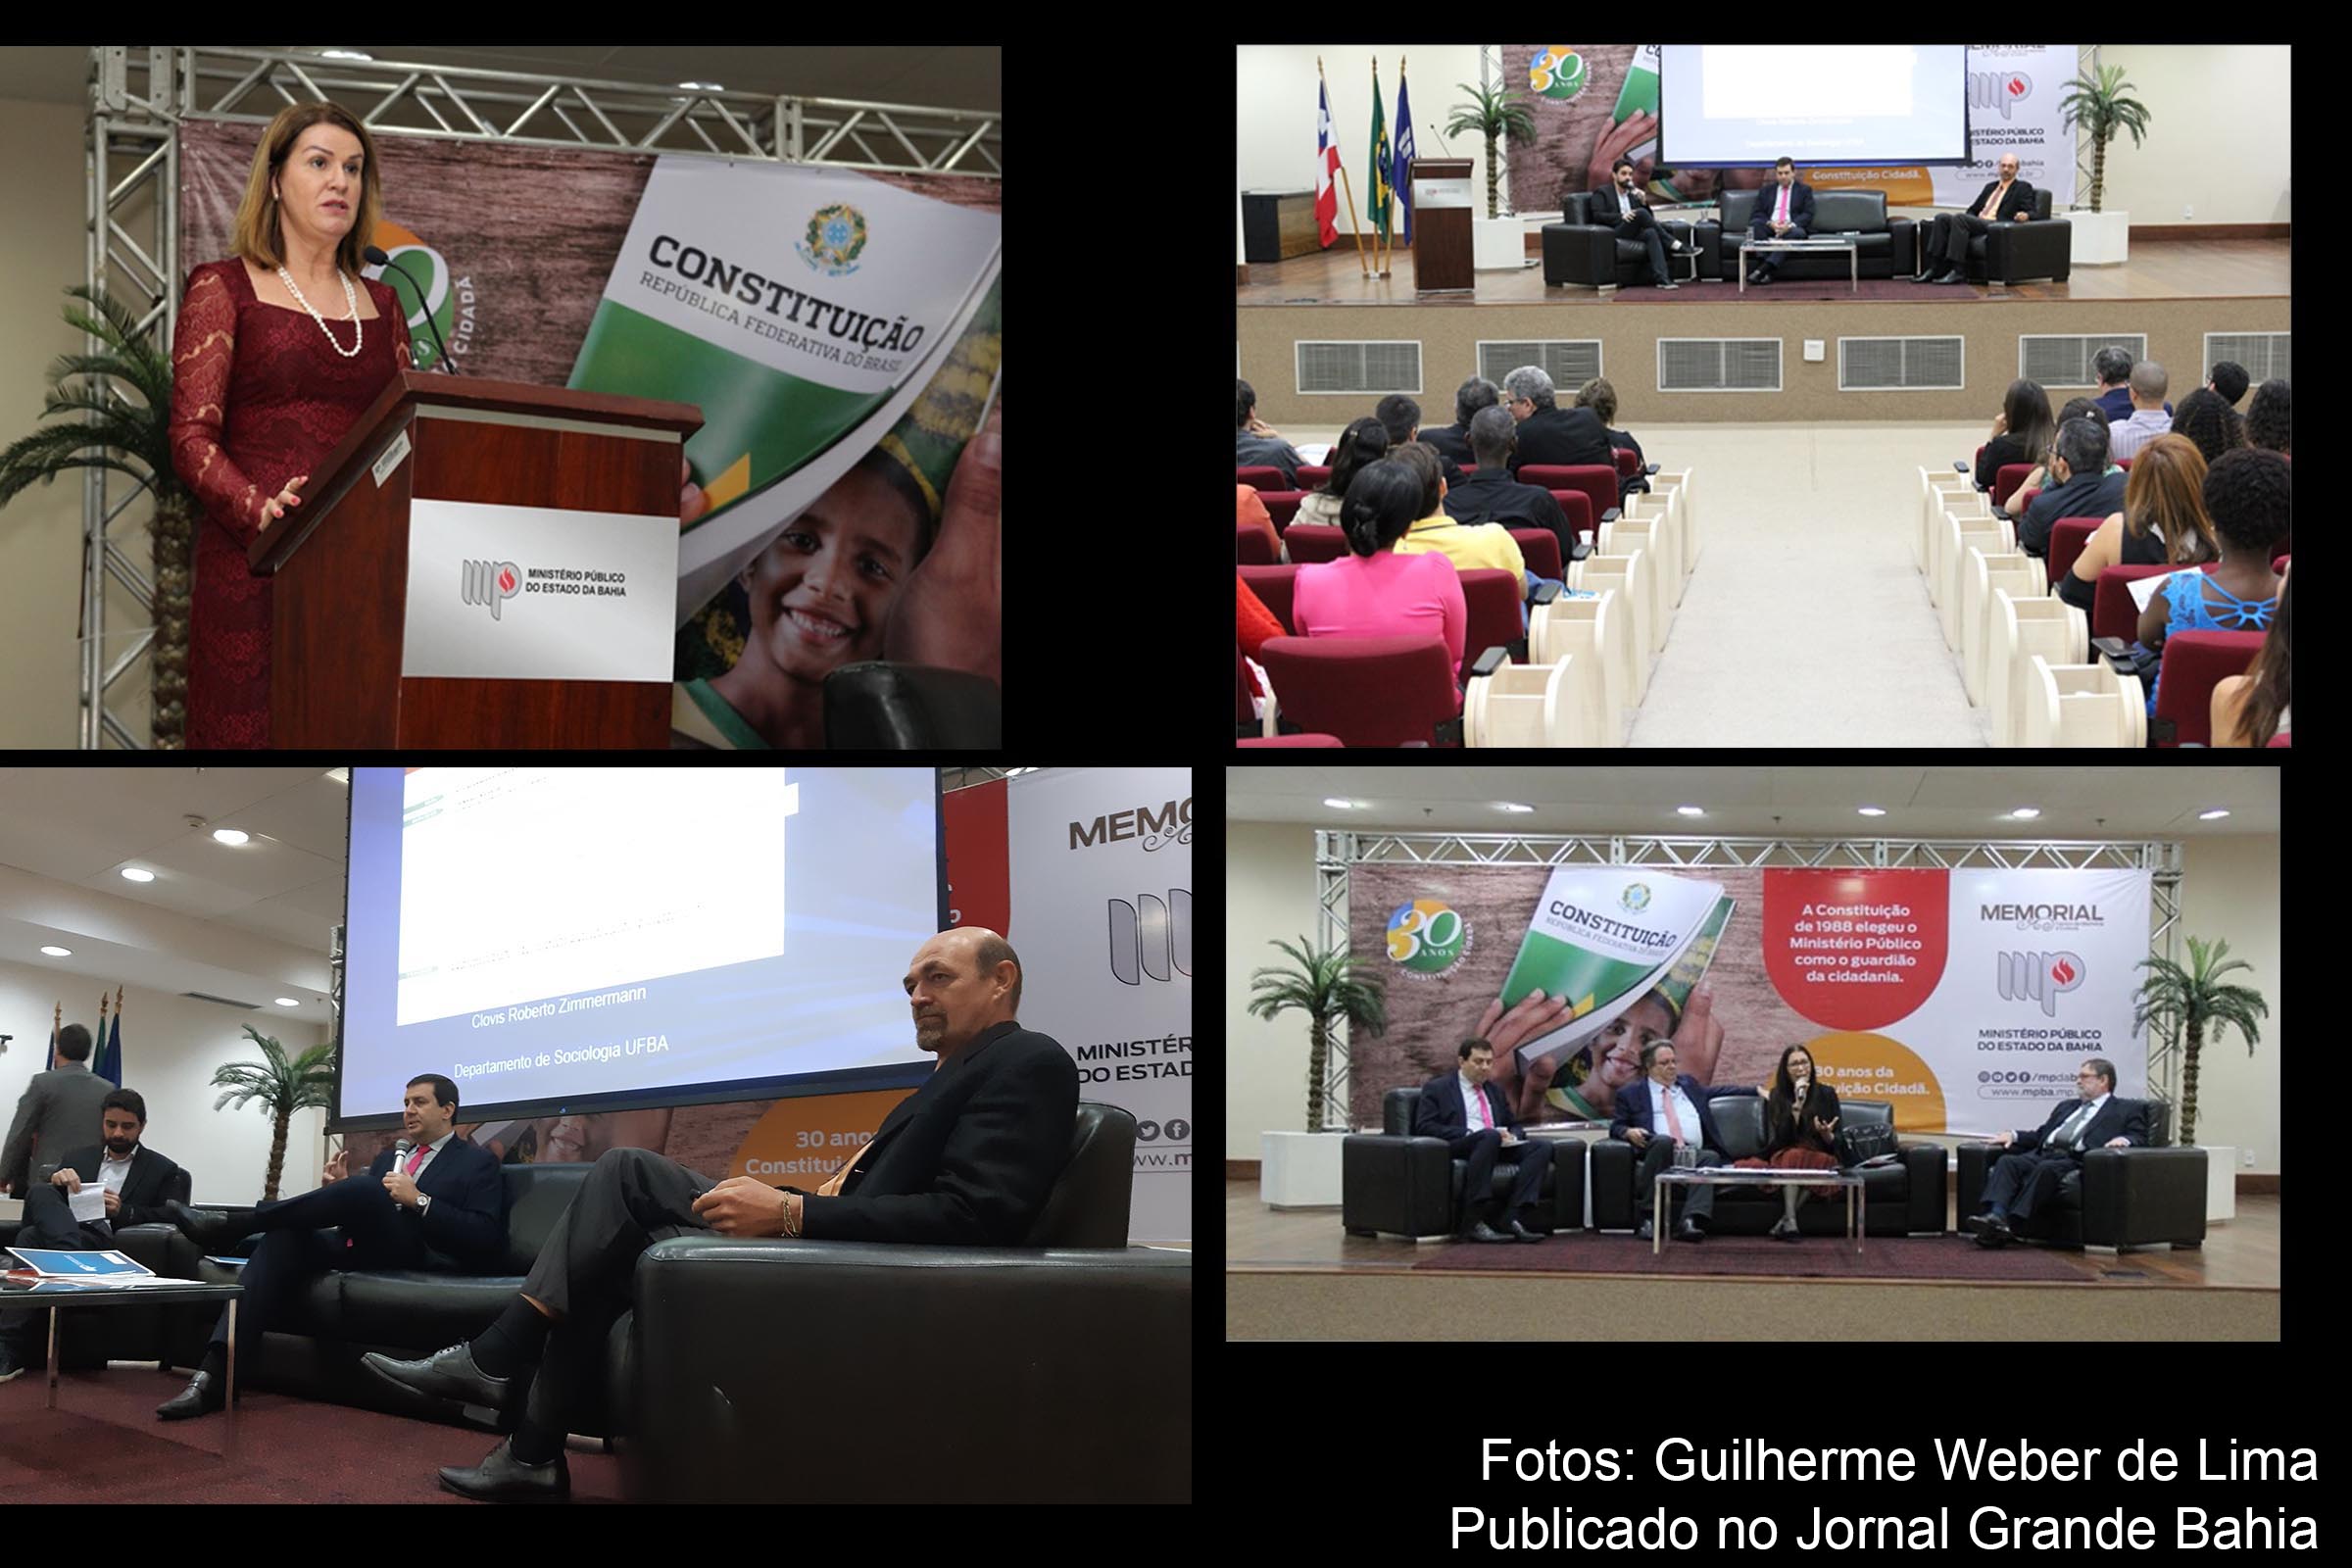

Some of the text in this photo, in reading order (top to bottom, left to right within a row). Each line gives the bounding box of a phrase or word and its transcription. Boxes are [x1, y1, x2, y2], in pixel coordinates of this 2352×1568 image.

[1530, 51, 1584, 92] 30
[648, 234, 925, 353] CONSTITUIÇÃO
[640, 270, 740, 325] REPÚBLICA
[744, 315, 841, 364] FEDERATIVA
[843, 351, 864, 368] DO
[528, 567, 626, 584] MINISTÉRIO PÚBLICO
[525, 582, 627, 597] DO ESTADO DA BAHIA
[1802, 904, 1911, 919] A Constituição
[1981, 904, 2104, 921] MEMORIAL
[1549, 900, 1678, 948] CONSTITUIÇÃO
[1794, 920, 1918, 935] de 1988 elegeu o
[1387, 909, 1463, 962] 30
[1789, 937, 1922, 950] Ministério Público
[1794, 954, 1917, 968] como o guardião
[1806, 970, 1904, 983] da cidadania.
[471, 987, 647, 1029] Clovis Roberto Zimmermann
[1979, 1028, 2102, 1040] MINISTÉRIO PÚBLICO
[1978, 1041, 2103, 1052] DO ESTADO DA BAHIA
[454, 1035, 669, 1079] Departamento de Sociologia UFBA
[1078, 1067, 1111, 1084] DO
[1838, 1066, 1873, 1078] anos
[1875, 1065, 1894, 1078] da
[1874, 1083, 1931, 1095] Cidadã.
[796, 1131, 876, 1149] 30 ano
[746, 1155, 849, 1175] Constitui
